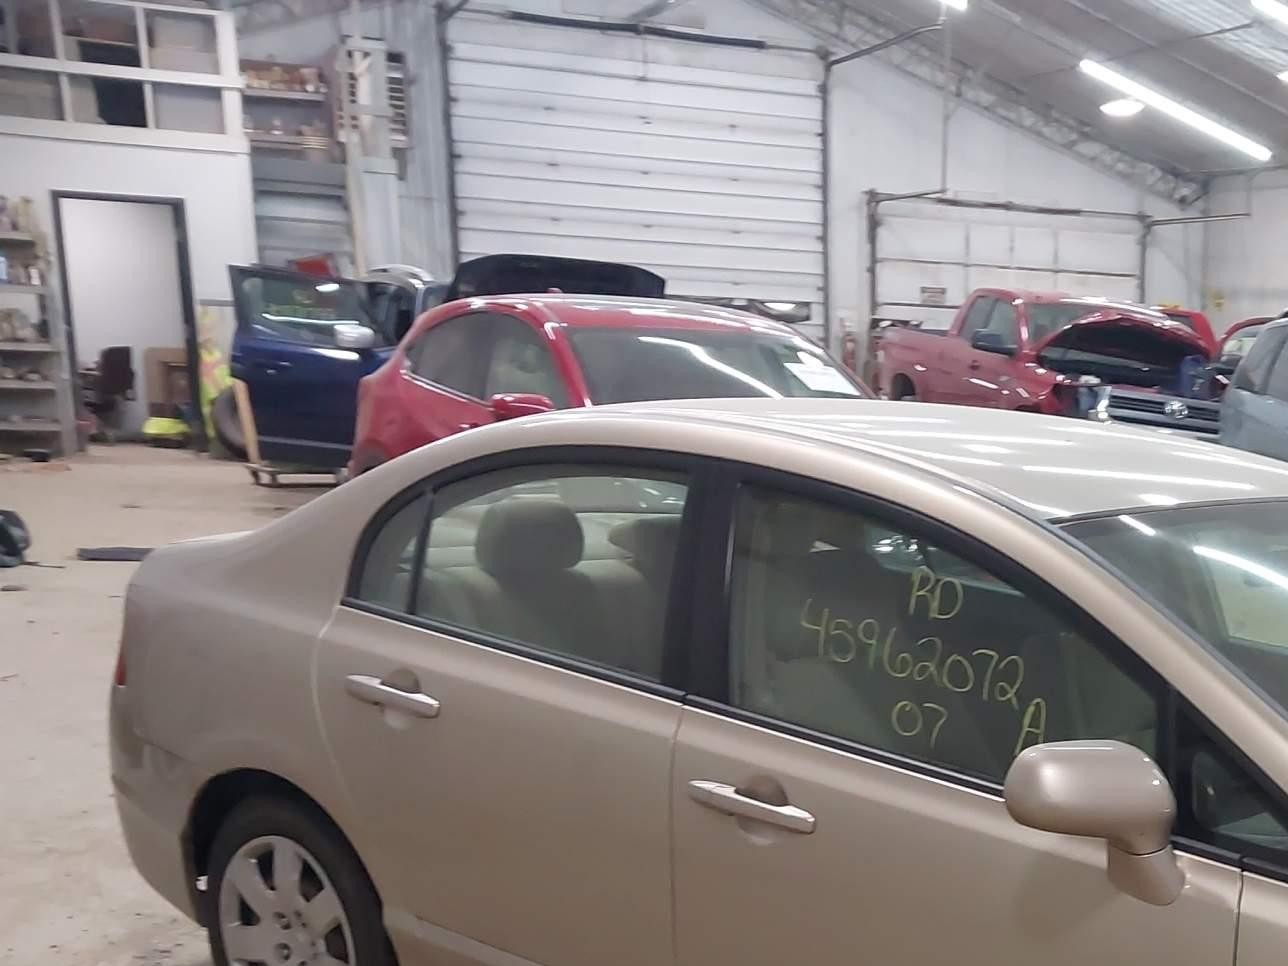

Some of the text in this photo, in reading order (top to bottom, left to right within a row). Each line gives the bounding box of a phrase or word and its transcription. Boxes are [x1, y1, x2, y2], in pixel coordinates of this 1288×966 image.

[909, 565, 964, 619] RD
[801, 598, 1026, 710] 45962072
[891, 701, 949, 749] 07
[1014, 697, 1047, 756] A
